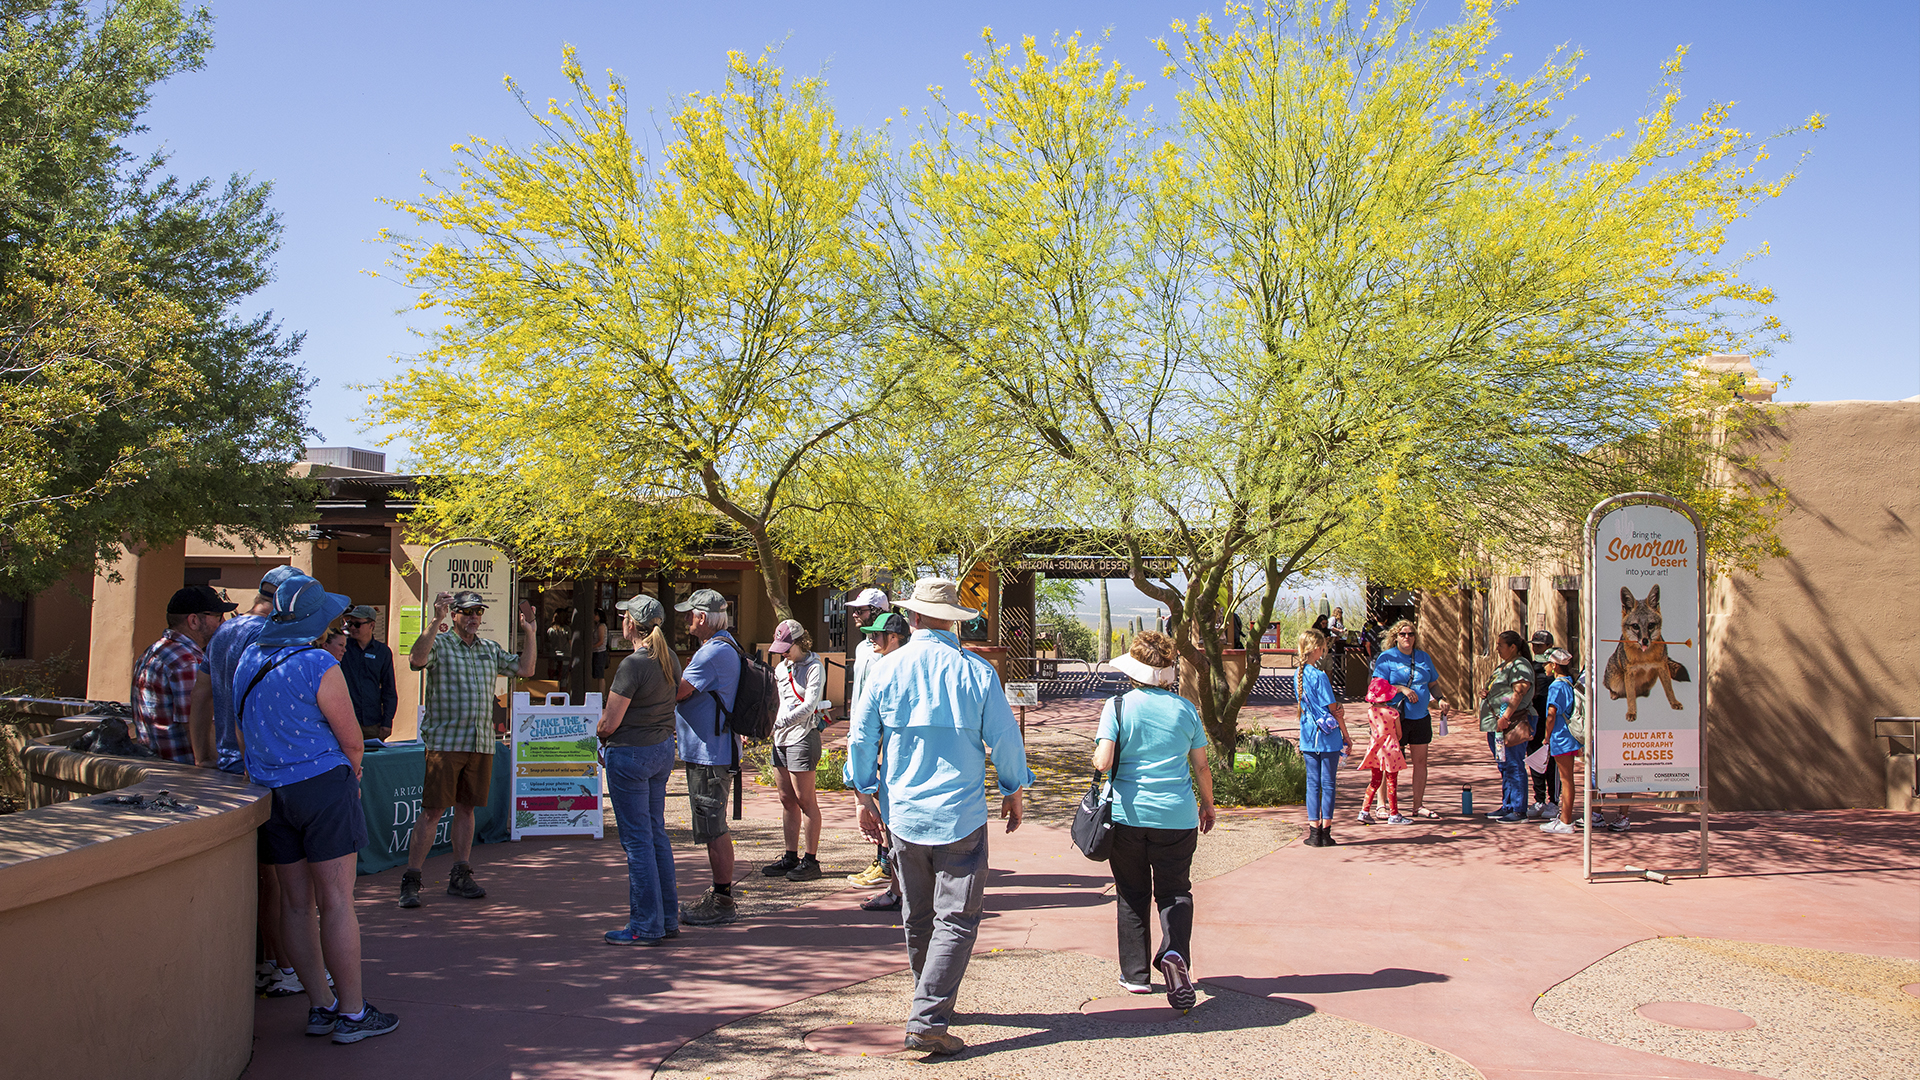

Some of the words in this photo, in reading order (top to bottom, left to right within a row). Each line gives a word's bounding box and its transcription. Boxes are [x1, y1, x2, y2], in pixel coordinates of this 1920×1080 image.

[1632, 531, 1650, 540] Bring
[1605, 537, 1688, 562] Sonoran
[447, 559, 469, 572] JOIN
[472, 559, 493, 573] OUR
[1017, 560, 1094, 570] ARIZONA-SONORA
[1100, 561, 1129, 570] DESER
[1651, 556, 1688, 567] Desert
[1640, 569, 1656, 577] your
[451, 573, 489, 589] PACK!
[535, 717, 560, 728] TAKE
[562, 716, 580, 725] THE
[530, 723, 587, 738] CHALLENGE!
[1622, 750, 1674, 761] CLASSES
